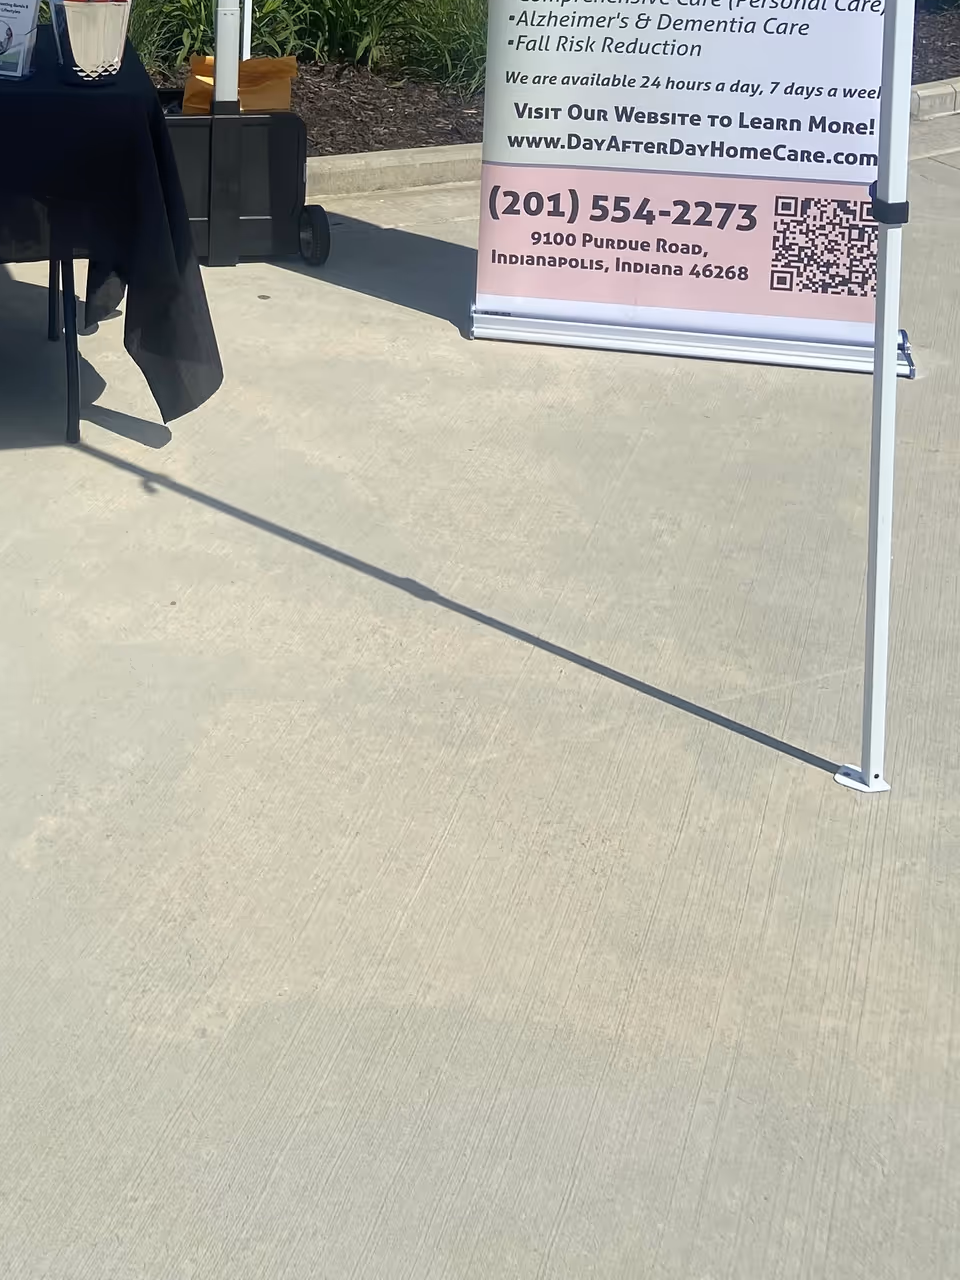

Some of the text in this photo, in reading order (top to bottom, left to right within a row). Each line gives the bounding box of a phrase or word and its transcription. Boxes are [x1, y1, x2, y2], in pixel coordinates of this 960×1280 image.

[516, 10, 809, 36] Alzheimer's & Dementia Care
[516, 35, 701, 56] Fall Risk Reduction
[506, 71, 528, 84] We
[532, 75, 557, 85] are
[561, 73, 636, 88] available
[640, 76, 661, 89] 24
[665, 76, 712, 91] hours
[715, 82, 725, 92] a
[729, 79, 763, 97] day,
[770, 82, 780, 94] 7
[784, 82, 824, 100] days
[827, 88, 838, 97] a
[489, 185, 757, 231] (201) 554-2273
[531, 231, 576, 246] 9100
[689, 264, 748, 281] 46268
